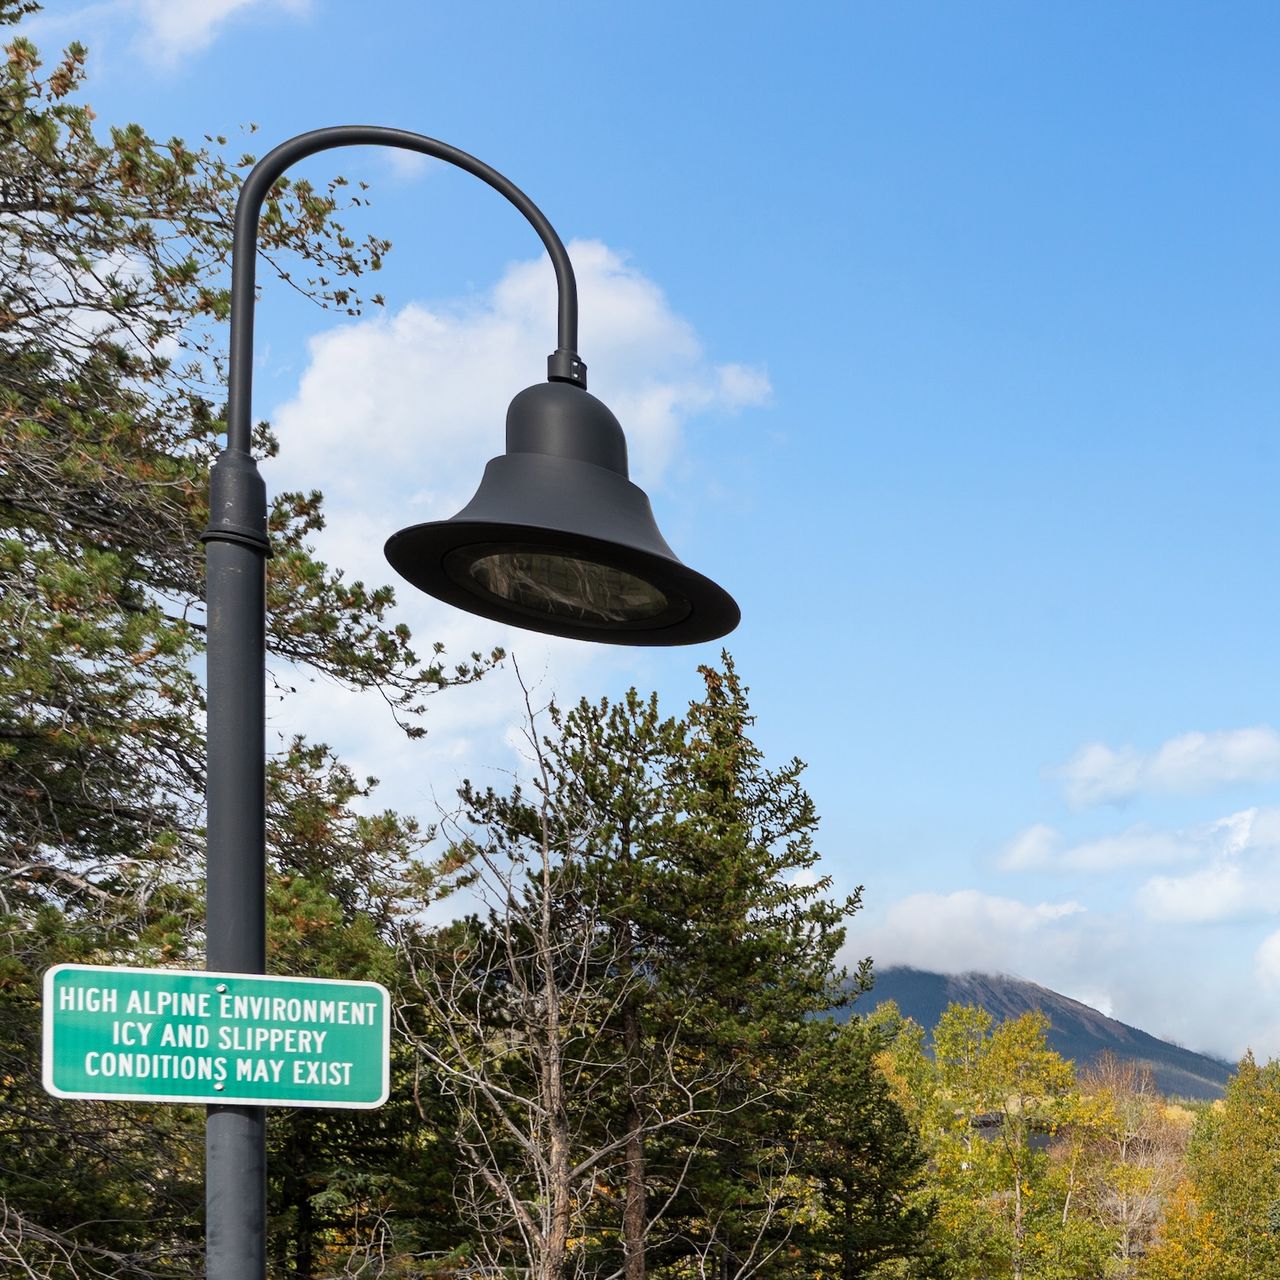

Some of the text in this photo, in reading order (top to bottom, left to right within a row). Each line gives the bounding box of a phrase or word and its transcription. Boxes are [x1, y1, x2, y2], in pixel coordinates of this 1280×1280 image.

[59, 986, 378, 1026] HIGH ALPINE ENVIRONMENT
[112, 1021, 328, 1054] ICY AND SLIPPERY
[85, 1051, 354, 1086] CONDITIONS MAY EXIST
